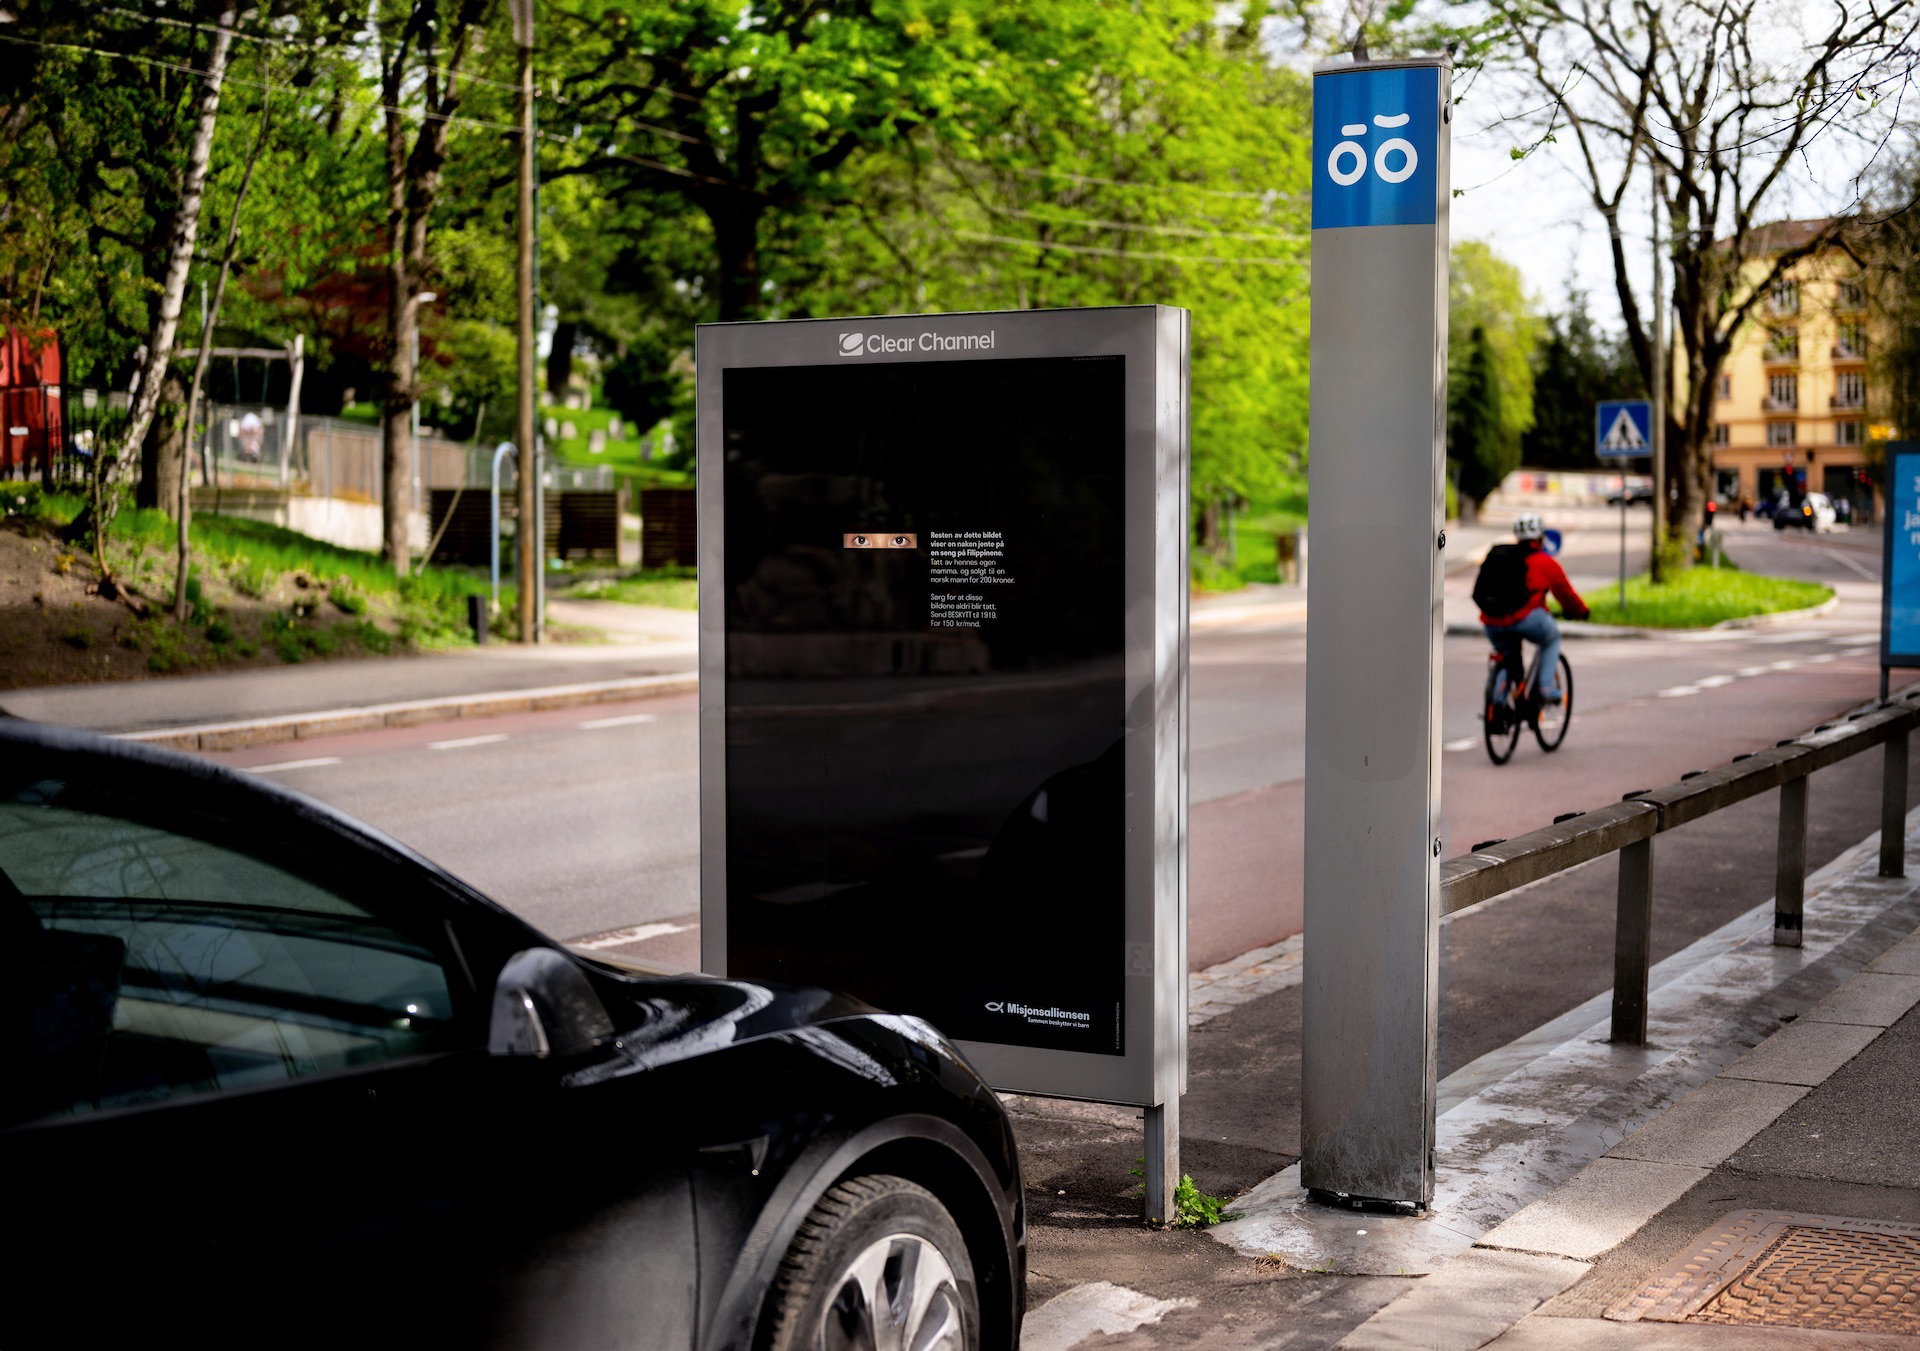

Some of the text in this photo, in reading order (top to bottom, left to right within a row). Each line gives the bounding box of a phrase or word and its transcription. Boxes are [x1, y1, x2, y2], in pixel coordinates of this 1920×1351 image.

[867, 330, 995, 353] Clear Channel
[1007, 1003, 1090, 1020] Misjonsalliansen
[1049, 1019, 1072, 1028] beskytter
